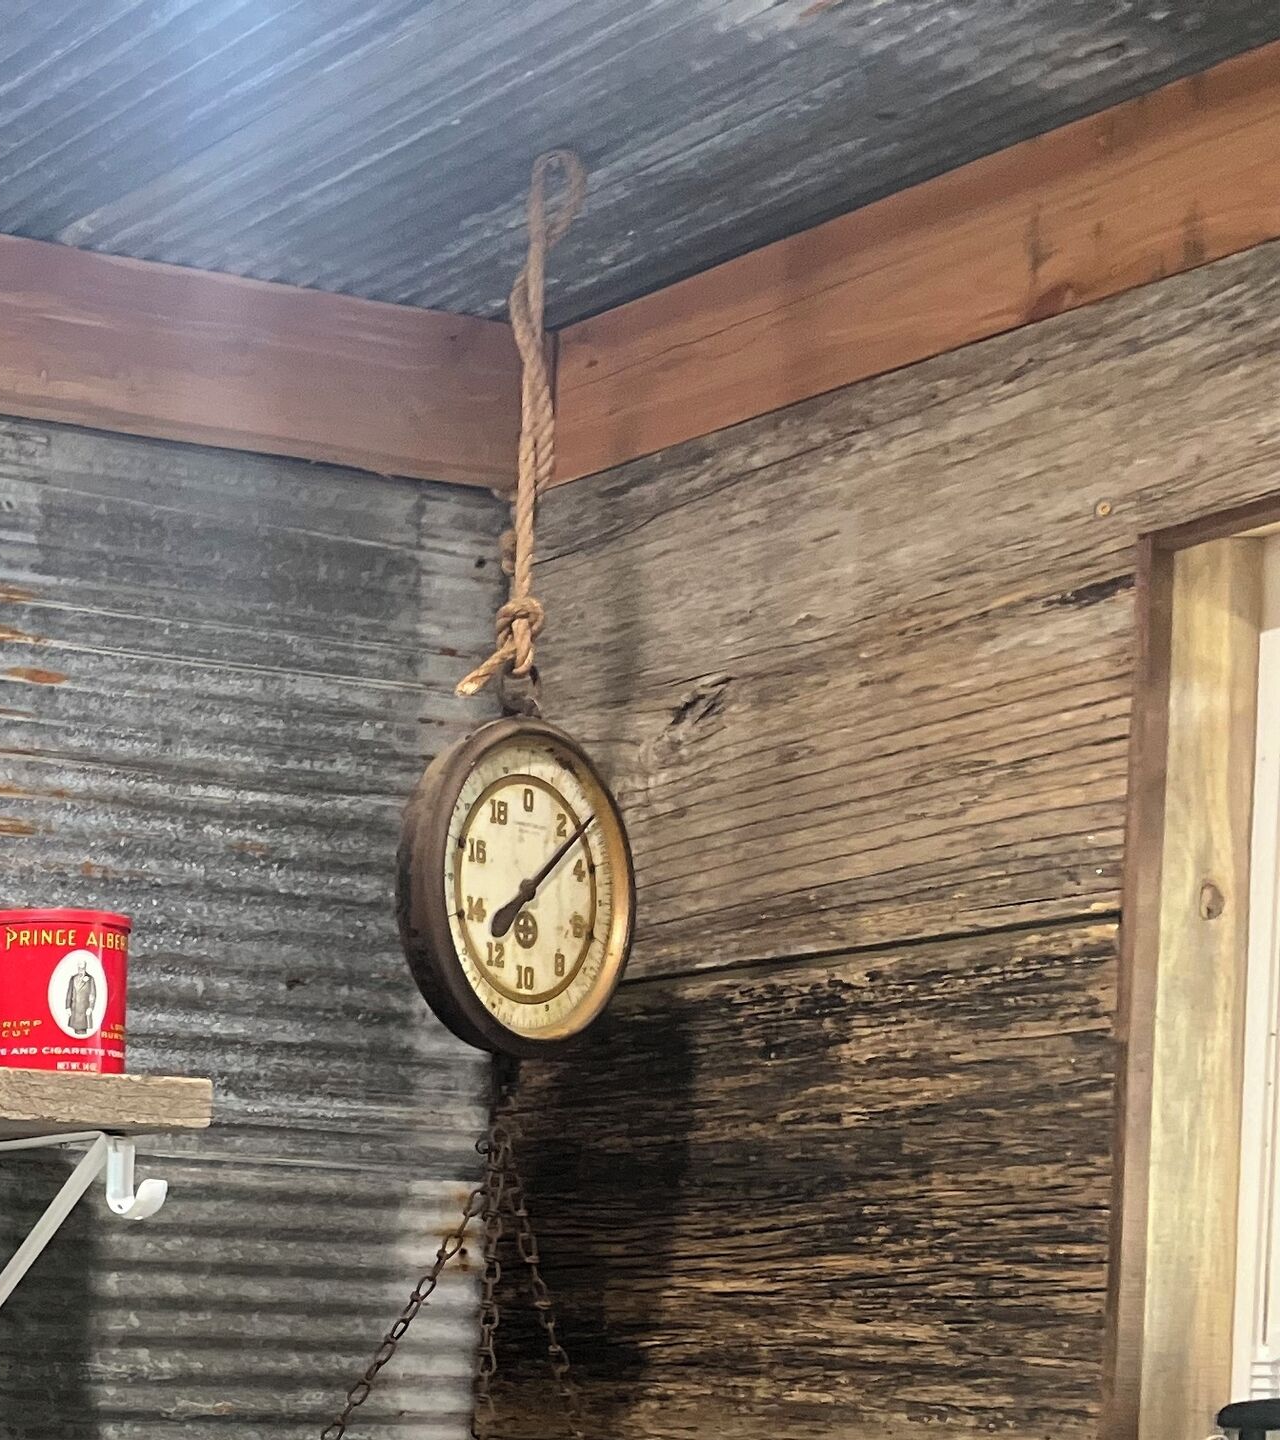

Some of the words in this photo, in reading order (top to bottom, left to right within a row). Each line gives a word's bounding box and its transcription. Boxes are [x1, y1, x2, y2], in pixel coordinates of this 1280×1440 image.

[490, 798, 508, 825] 18
[524, 788, 534, 812] 0
[556, 813, 567, 837] 2
[468, 838, 486, 864] 16
[573, 858, 586, 882] 4
[467, 896, 486, 922] 14
[6, 926, 76, 950] PRINCE
[486, 942, 505, 968] 12
[554, 952, 565, 977] 8
[516, 965, 534, 990] 10
[1, 1028, 30, 1038] CUT
[10, 1047, 38, 1055] AND
[42, 1046, 106, 1057] CIGARETTE
